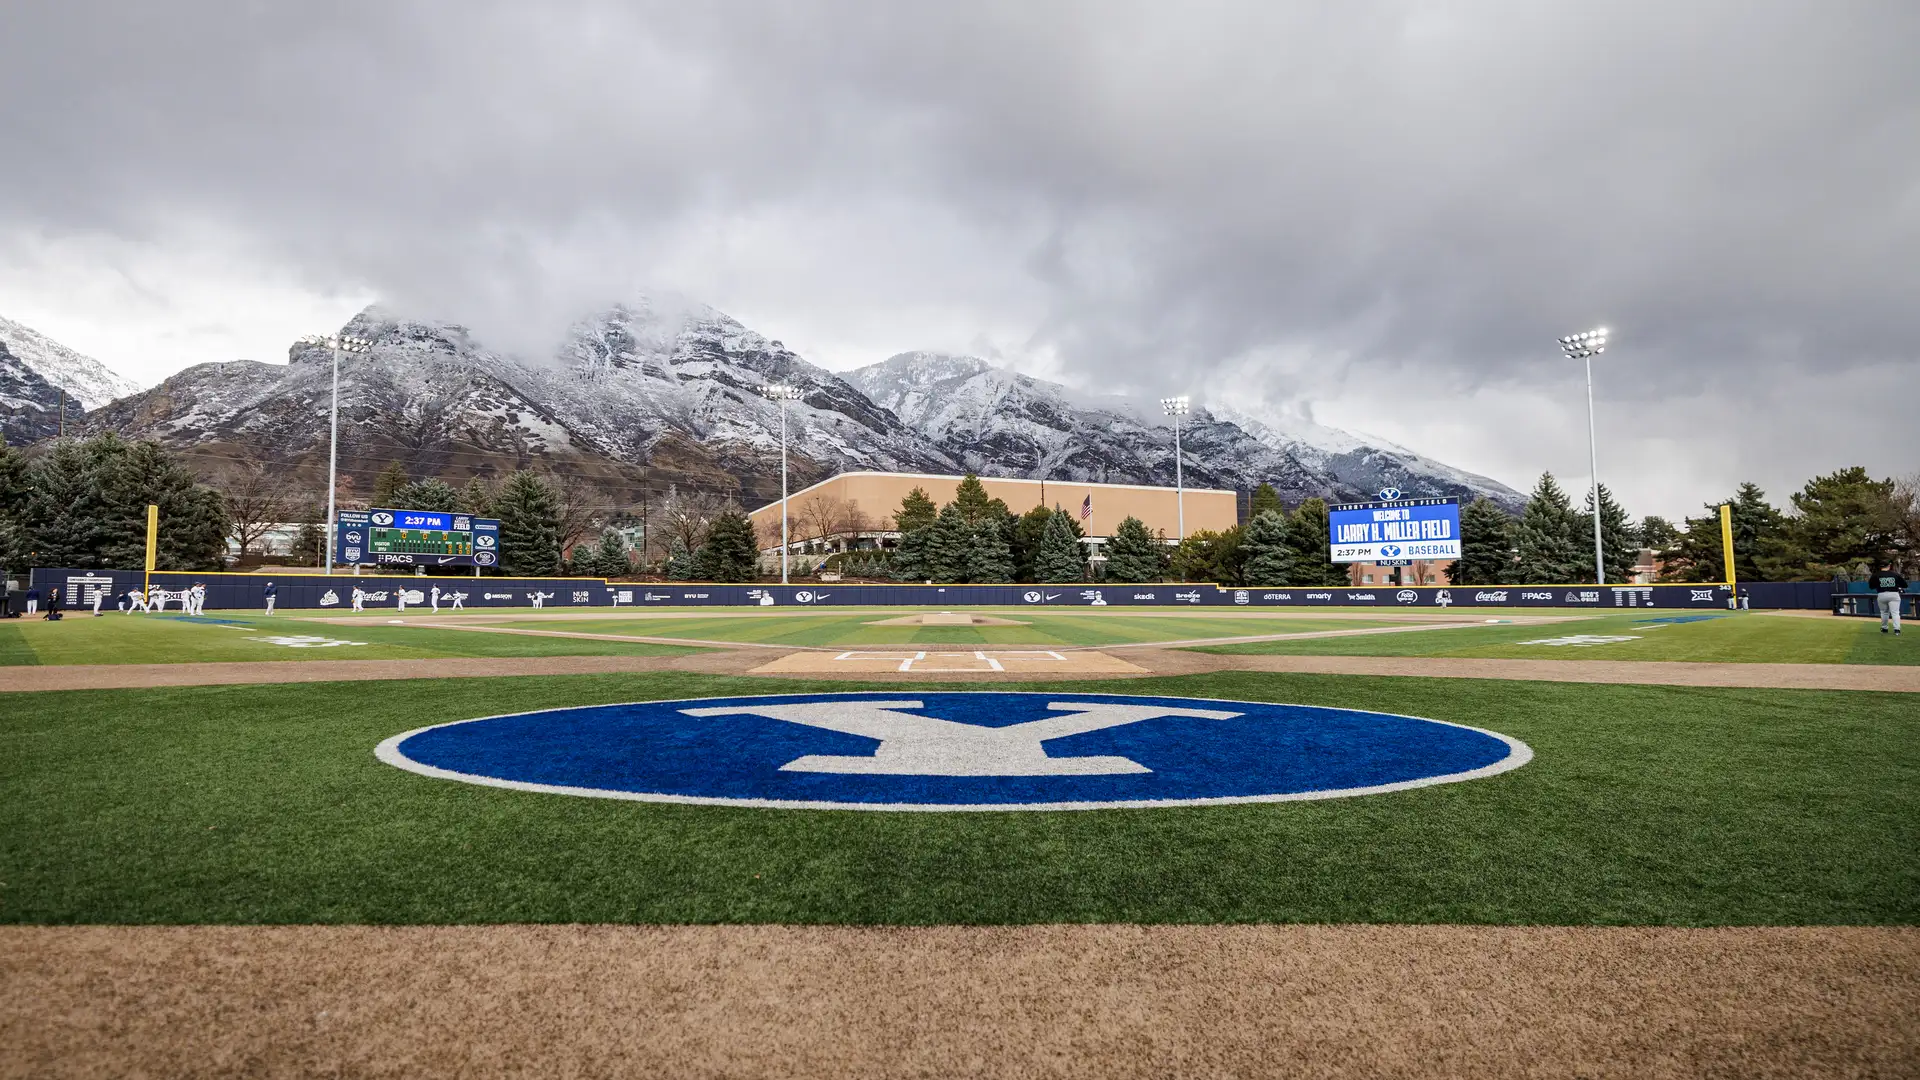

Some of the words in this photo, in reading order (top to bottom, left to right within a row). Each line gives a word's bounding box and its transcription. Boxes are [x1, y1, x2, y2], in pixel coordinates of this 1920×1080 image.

[1420, 498, 1448, 506] FIELD
[1374, 510, 1401, 522] WELCOME
[1402, 509, 1410, 520] TO
[404, 516, 425, 525] 2:37
[427, 517, 441, 526] PM
[453, 523, 471, 531] FIELD
[1337, 524, 1370, 543] LARRY
[1372, 523, 1382, 541] H.
[1383, 521, 1420, 540] MILLER
[1421, 519, 1451, 539] FIELD
[1337, 549, 1356, 557] 2:37
[1358, 548, 1371, 556] PM
[1409, 545, 1455, 555] BASEBALL
[384, 554, 413, 563] PACS
[1527, 592, 1552, 600] PACS
